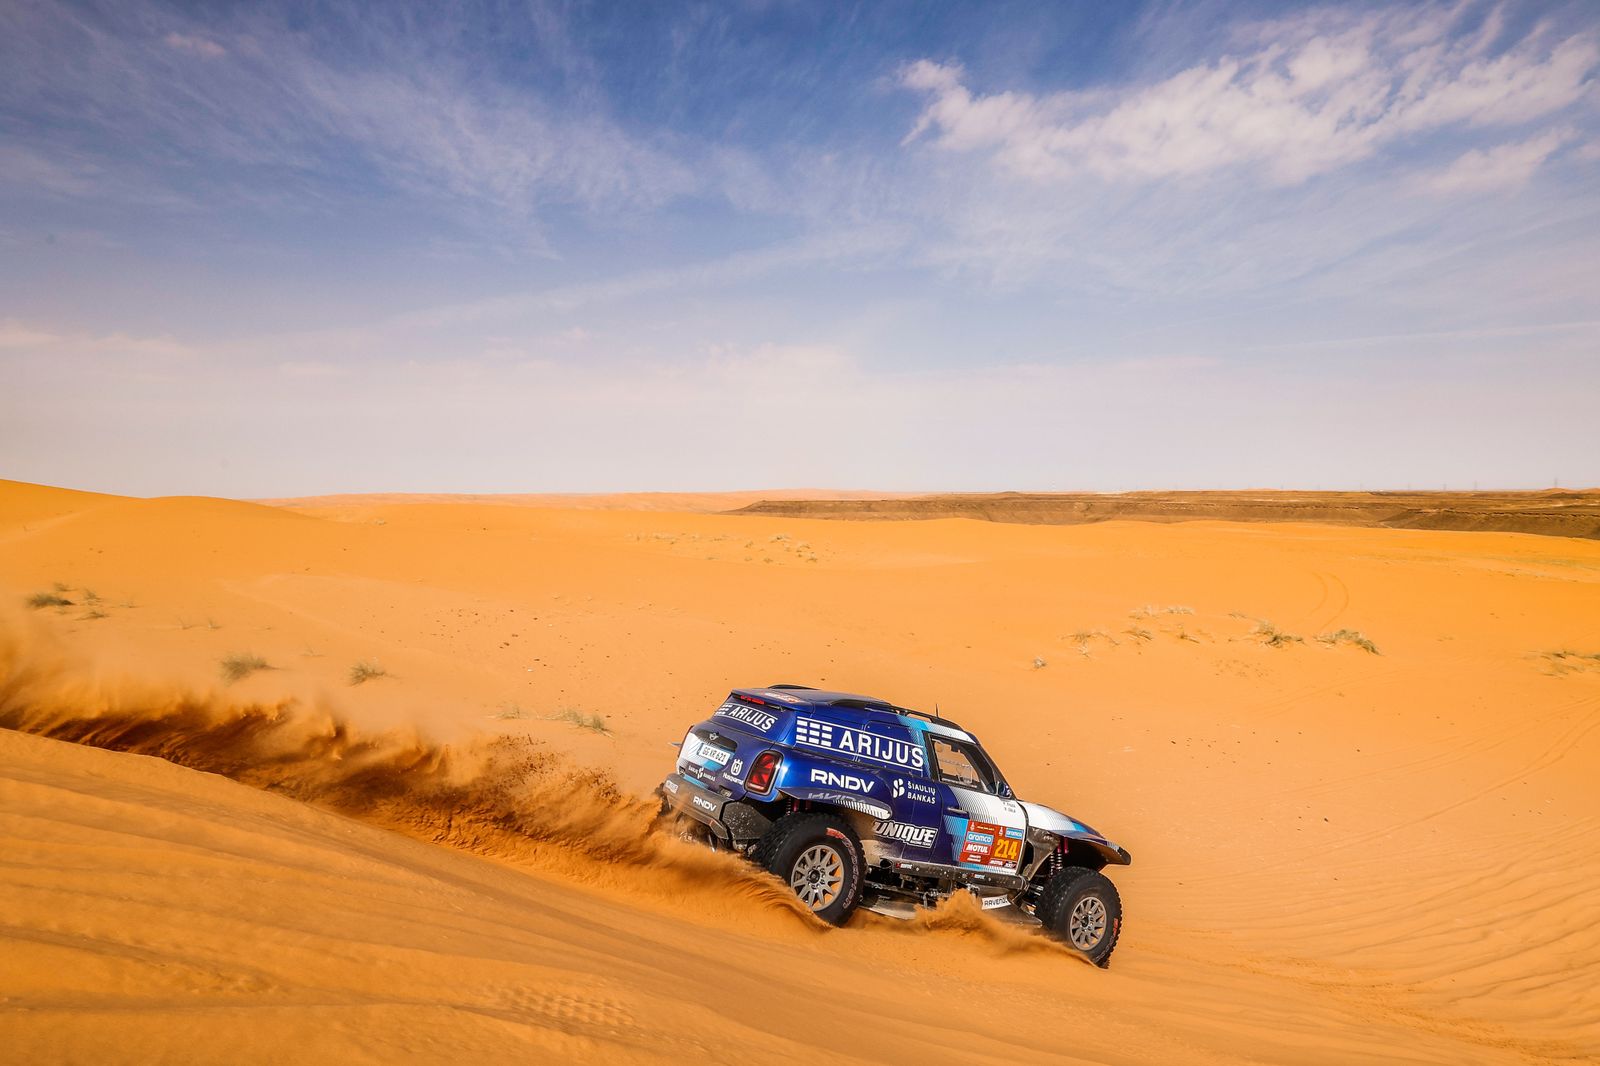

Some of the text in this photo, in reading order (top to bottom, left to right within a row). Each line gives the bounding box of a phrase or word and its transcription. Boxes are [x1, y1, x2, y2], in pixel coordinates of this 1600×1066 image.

[728, 704, 775, 730] ARIJUS
[839, 730, 924, 768] ARIJUS
[810, 768, 875, 793] RNDV
[907, 780, 936, 795] ŠIAULIŲ
[692, 796, 717, 812] RNDV
[907, 792, 936, 805] BANKAS
[872, 821, 937, 844] UNIQUE
[968, 834, 992, 843] aramco
[966, 843, 988, 854] MOTUL
[994, 838, 1018, 859] 214
